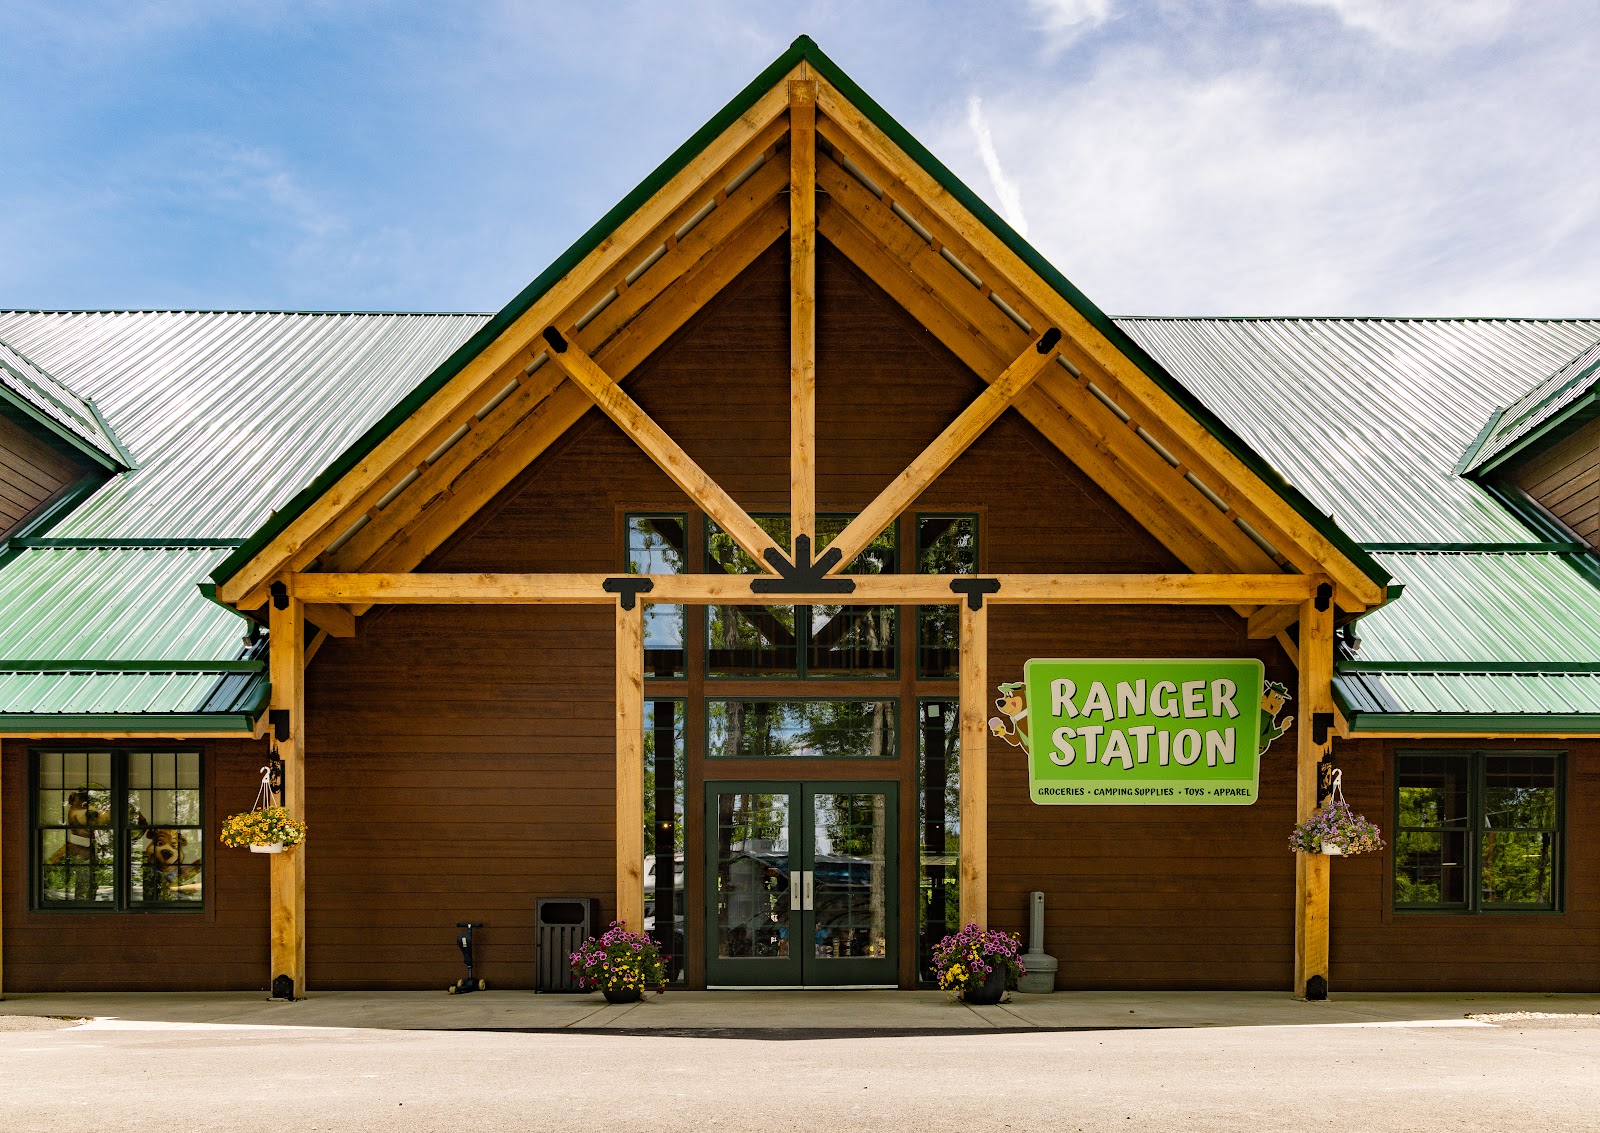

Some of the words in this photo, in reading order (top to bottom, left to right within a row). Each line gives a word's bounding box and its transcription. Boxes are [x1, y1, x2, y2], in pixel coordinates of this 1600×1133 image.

[1050, 678, 1240, 722] RANGER
[1048, 725, 1236, 770] STATION
[1038, 787, 1085, 796] GROCERIES
[1093, 787, 1133, 796] CAMPING
[1134, 787, 1174, 796] SUPPLIES
[1184, 787, 1205, 796] TOYS
[1213, 787, 1251, 797] APPAREL
